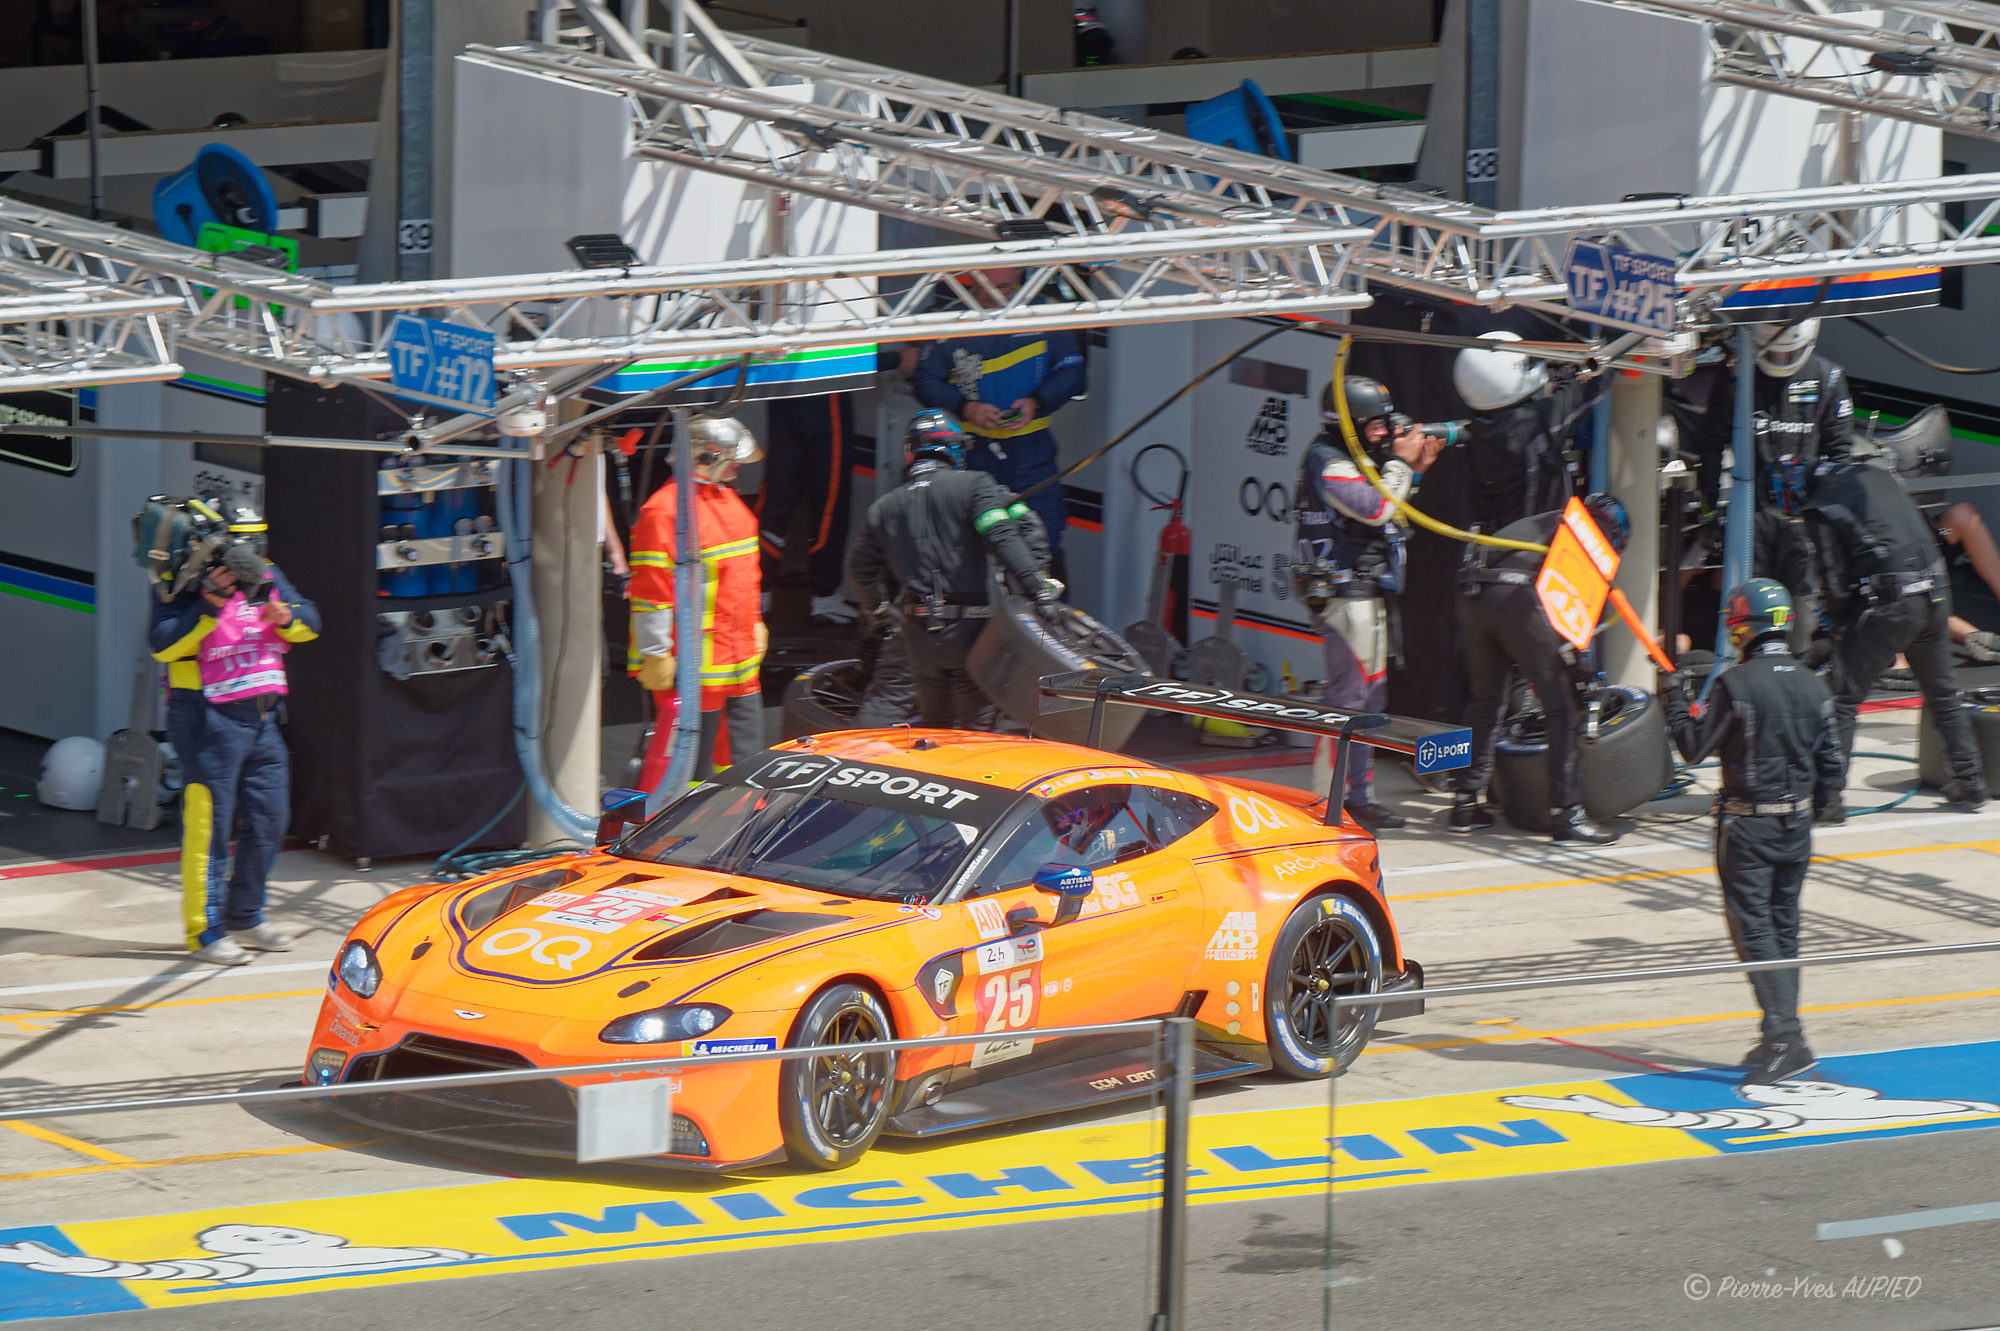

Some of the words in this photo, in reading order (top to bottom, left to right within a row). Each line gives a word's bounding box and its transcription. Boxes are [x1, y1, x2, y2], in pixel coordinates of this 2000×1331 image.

[1466, 151, 1498, 178] 38
[399, 222, 432, 250] 39
[1569, 263, 1607, 299] TF
[1631, 257, 1675, 283] SPORT
[1613, 279, 1675, 331] #25
[393, 340, 426, 377] TF
[1769, 420, 1815, 433] SPORT
[1240, 476, 1291, 524] OQ
[1149, 686, 1217, 700] TF
[1216, 698, 1351, 724] SPOR
[1421, 748, 1434, 760] TF
[1437, 742, 1470, 758] SPORT
[768, 760, 828, 779] TF
[827, 767, 980, 810] SPORT
[1228, 795, 1289, 834] OQ
[1059, 875, 1092, 886] ARTISAN
[1093, 871, 1141, 911] 5G
[533, 895, 577, 904] AM
[565, 896, 656, 921] 25
[974, 900, 1008, 933] AM
[481, 927, 593, 972] OQ
[1206, 930, 1258, 949] MHD
[938, 980, 950, 994] TF
[983, 968, 1034, 1034] 25
[709, 1042, 769, 1055] MICHELIN
[496, 1118, 1569, 1242] MICHELIN
